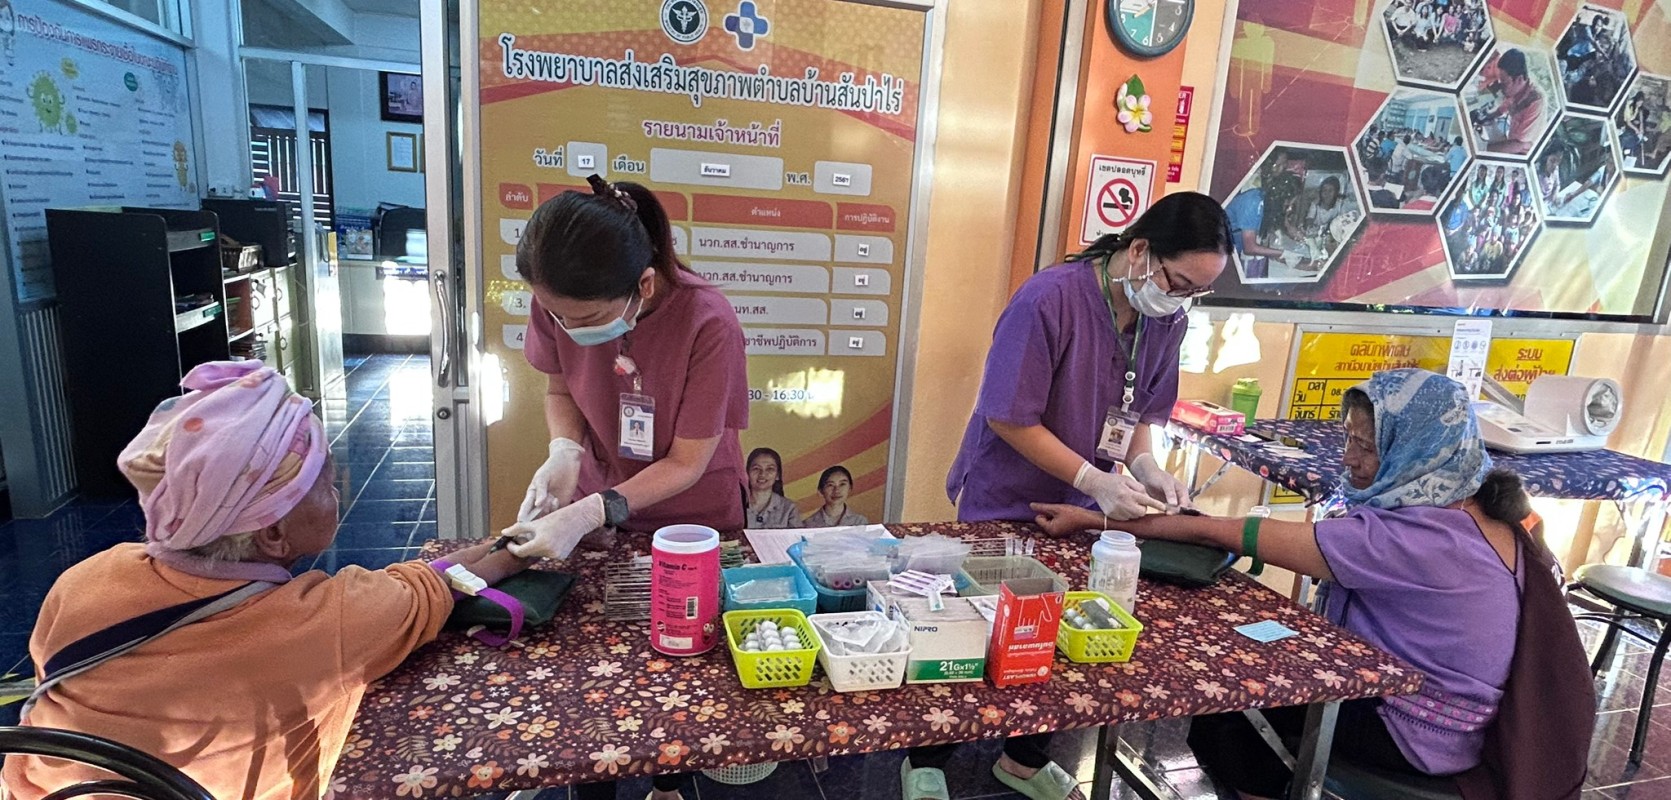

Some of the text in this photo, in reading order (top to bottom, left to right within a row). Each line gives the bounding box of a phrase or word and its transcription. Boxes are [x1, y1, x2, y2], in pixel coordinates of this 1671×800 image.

[1142, 36, 1149, 46] 6
[501, 36, 903, 112] โรงพยาบาลส่งเสริมสุขภาพตำบลบ้านสันป่าไร่
[643, 120, 780, 146] รายนามเจ้าหน้าที่
[534, 147, 563, 167] วันที่
[613, 155, 645, 172] เดือน
[786, 172, 811, 184] พ.ศ.
[1099, 164, 1147, 178] เขตปลอดบุหรี่
[505, 191, 890, 225] ลำดับ ตำแหน่ง การปฏิบัติงาน
[698, 236, 795, 253] นวก.สส.ชำนาญการ
[515, 297, 526, 309] 3.
[1517, 348, 1543, 360] ระบบ
[774, 389, 805, 400] 16.30
[658, 560, 681, 571] Vitamin
[681, 563, 688, 571] C
[914, 625, 938, 633] NIPRO
